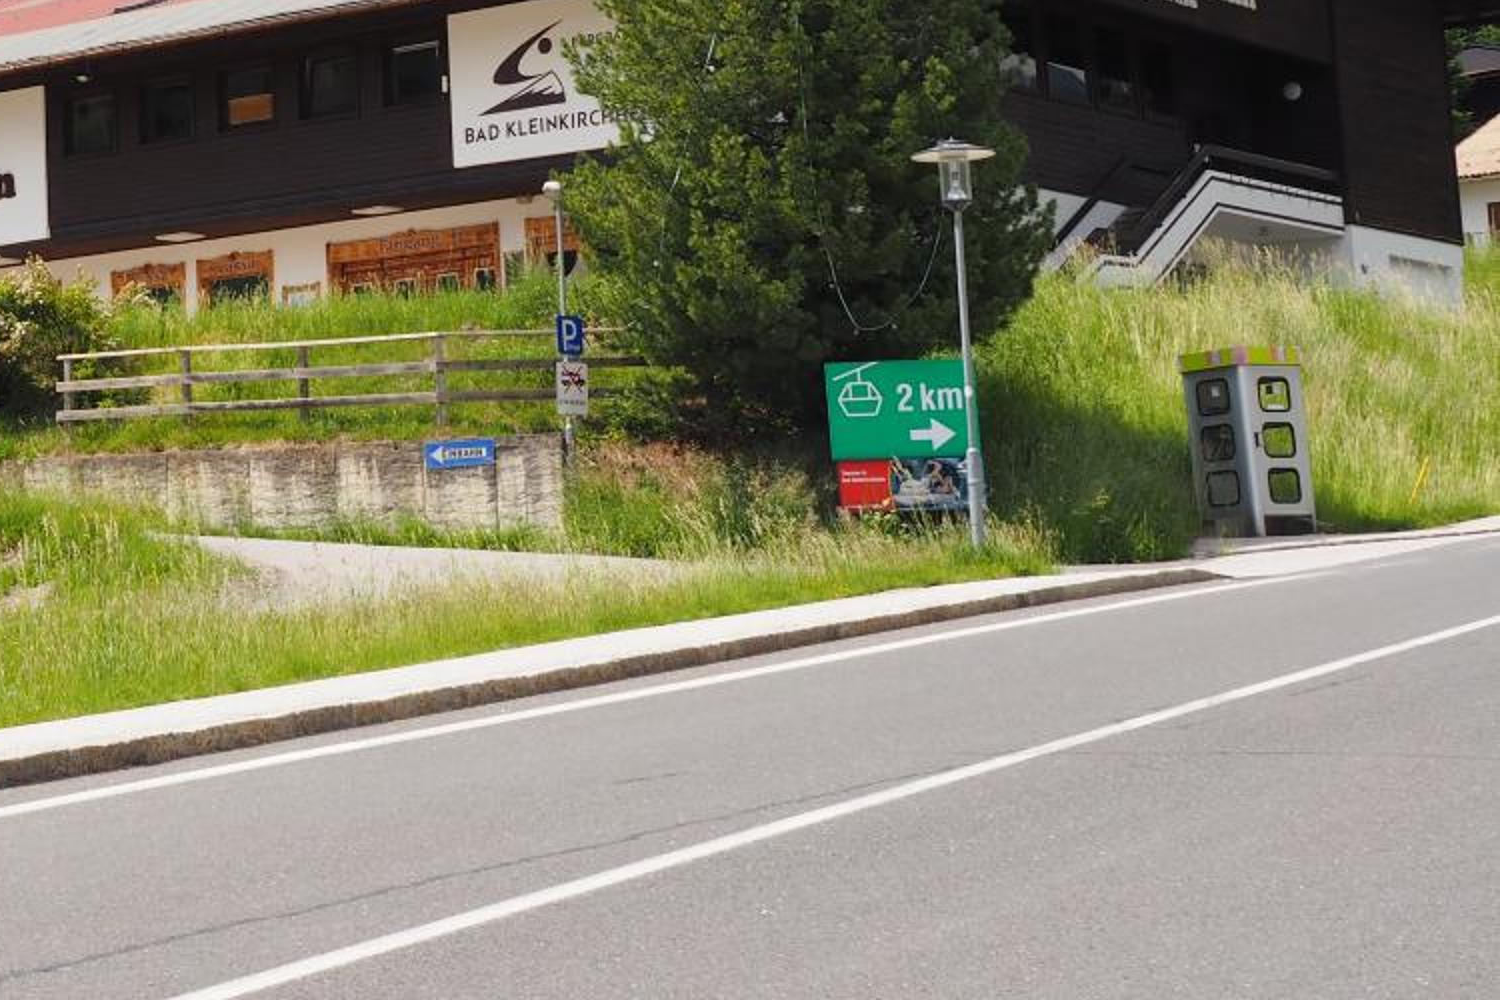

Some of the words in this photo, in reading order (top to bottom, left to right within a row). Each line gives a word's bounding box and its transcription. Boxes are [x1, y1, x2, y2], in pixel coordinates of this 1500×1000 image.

[465, 124, 499, 145] BAD
[562, 319, 577, 352] P
[896, 383, 915, 412] 2
[919, 382, 963, 411] km
